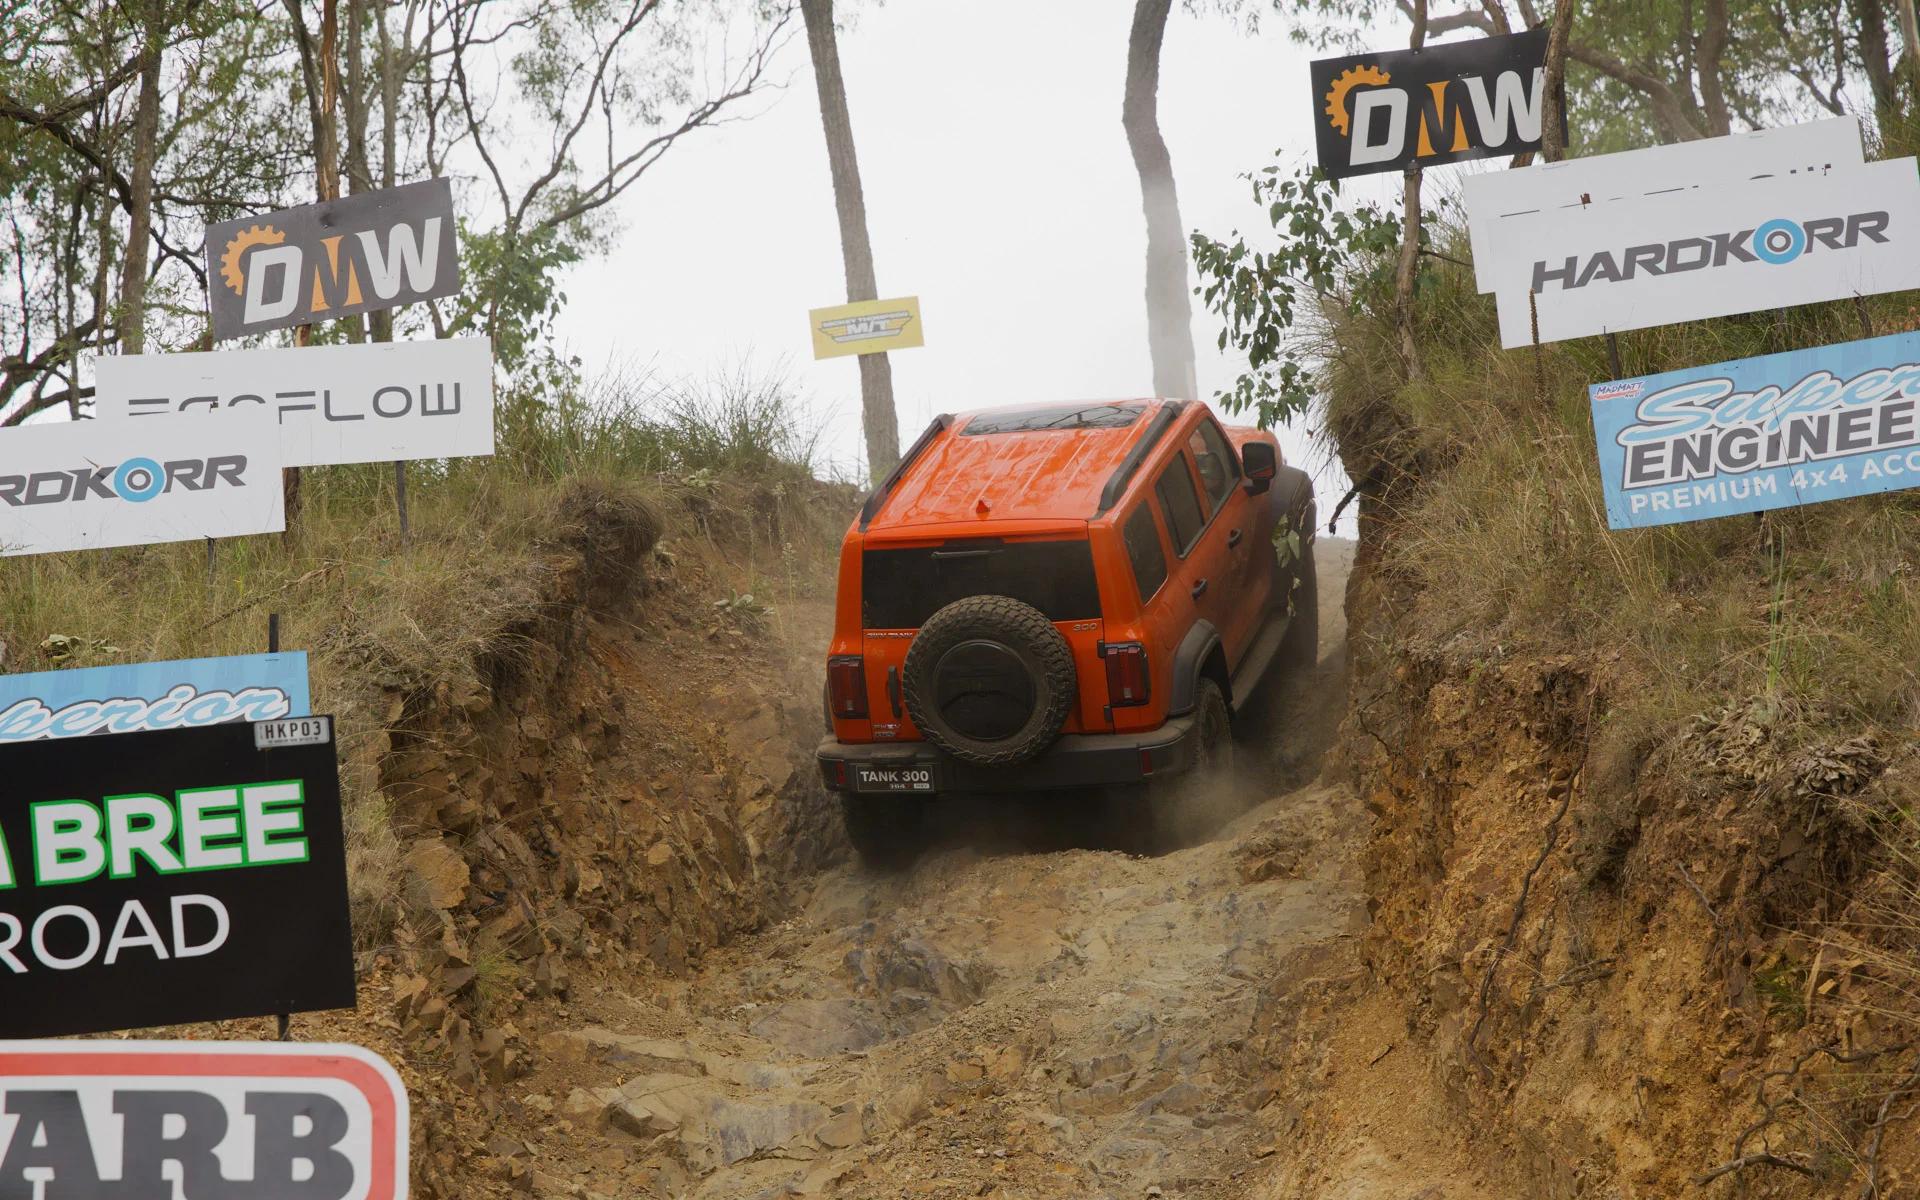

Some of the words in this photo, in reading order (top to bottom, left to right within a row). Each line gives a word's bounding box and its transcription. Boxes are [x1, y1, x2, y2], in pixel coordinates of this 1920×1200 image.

[1349, 66, 1547, 167] DMW
[243, 216, 442, 324] DMW
[1530, 210, 1890, 294] HARDKORR
[1626, 399, 1917, 487] ENGINEE
[1630, 474, 1777, 514] PREMIUM
[1789, 462, 1848, 489] 4x4
[860, 770, 898, 782] TANK
[902, 770, 929, 782] 300
[30, 779, 309, 886] BREE
[0, 1089, 355, 1200] ARB
